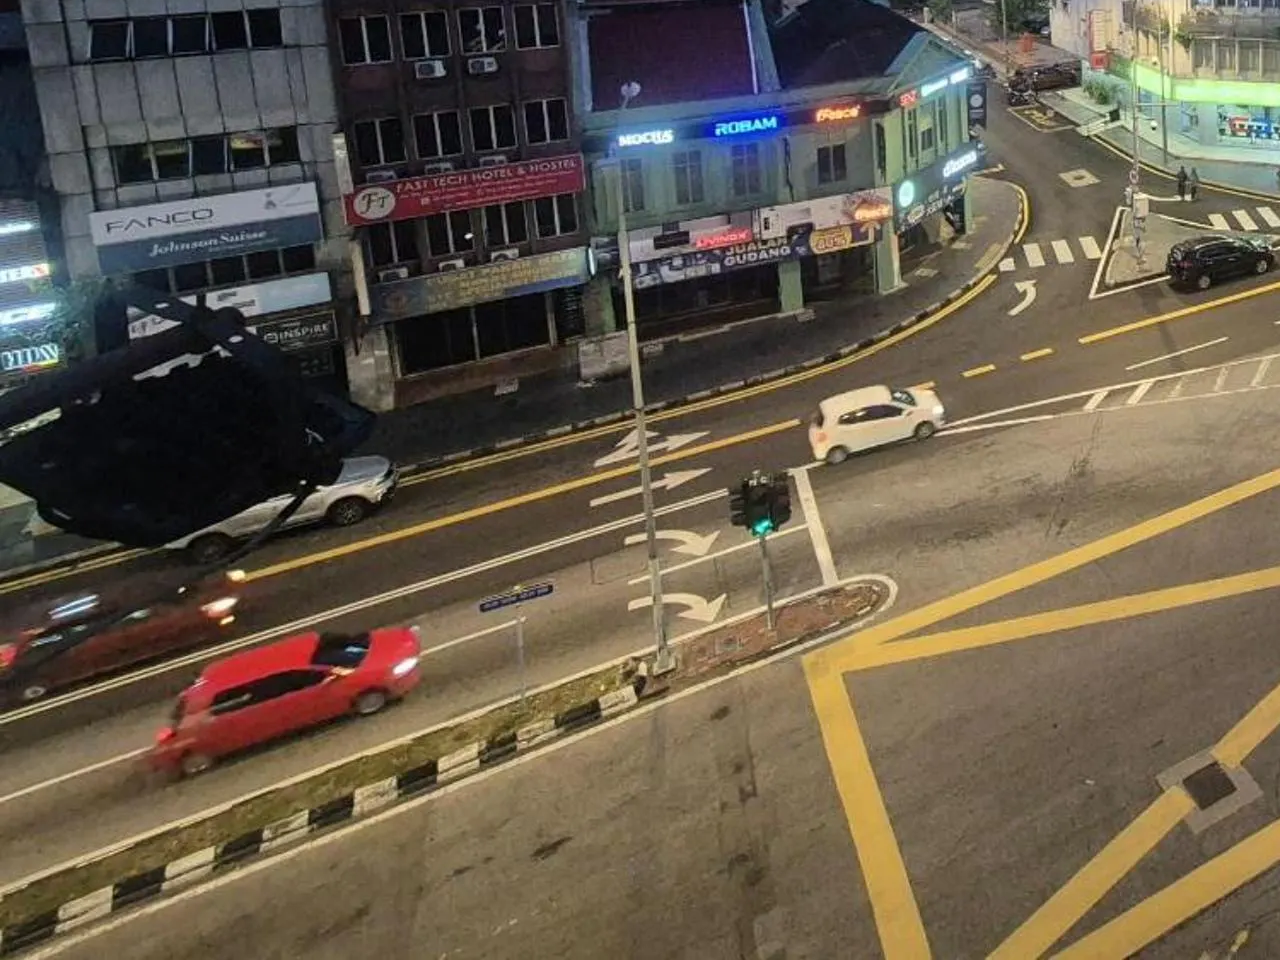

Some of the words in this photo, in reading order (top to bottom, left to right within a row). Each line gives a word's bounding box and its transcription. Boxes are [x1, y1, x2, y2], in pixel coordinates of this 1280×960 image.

[715, 117, 777, 136] ROBAM
[396, 180, 428, 193] FAST
[432, 176, 467, 189] TECH
[472, 170, 514, 184] HOTEL
[529, 160, 577, 173] HOSTEL
[105, 208, 214, 234] FANCO
[149, 236, 218, 257] Johnson
[724, 246, 791, 267] GUDANG
